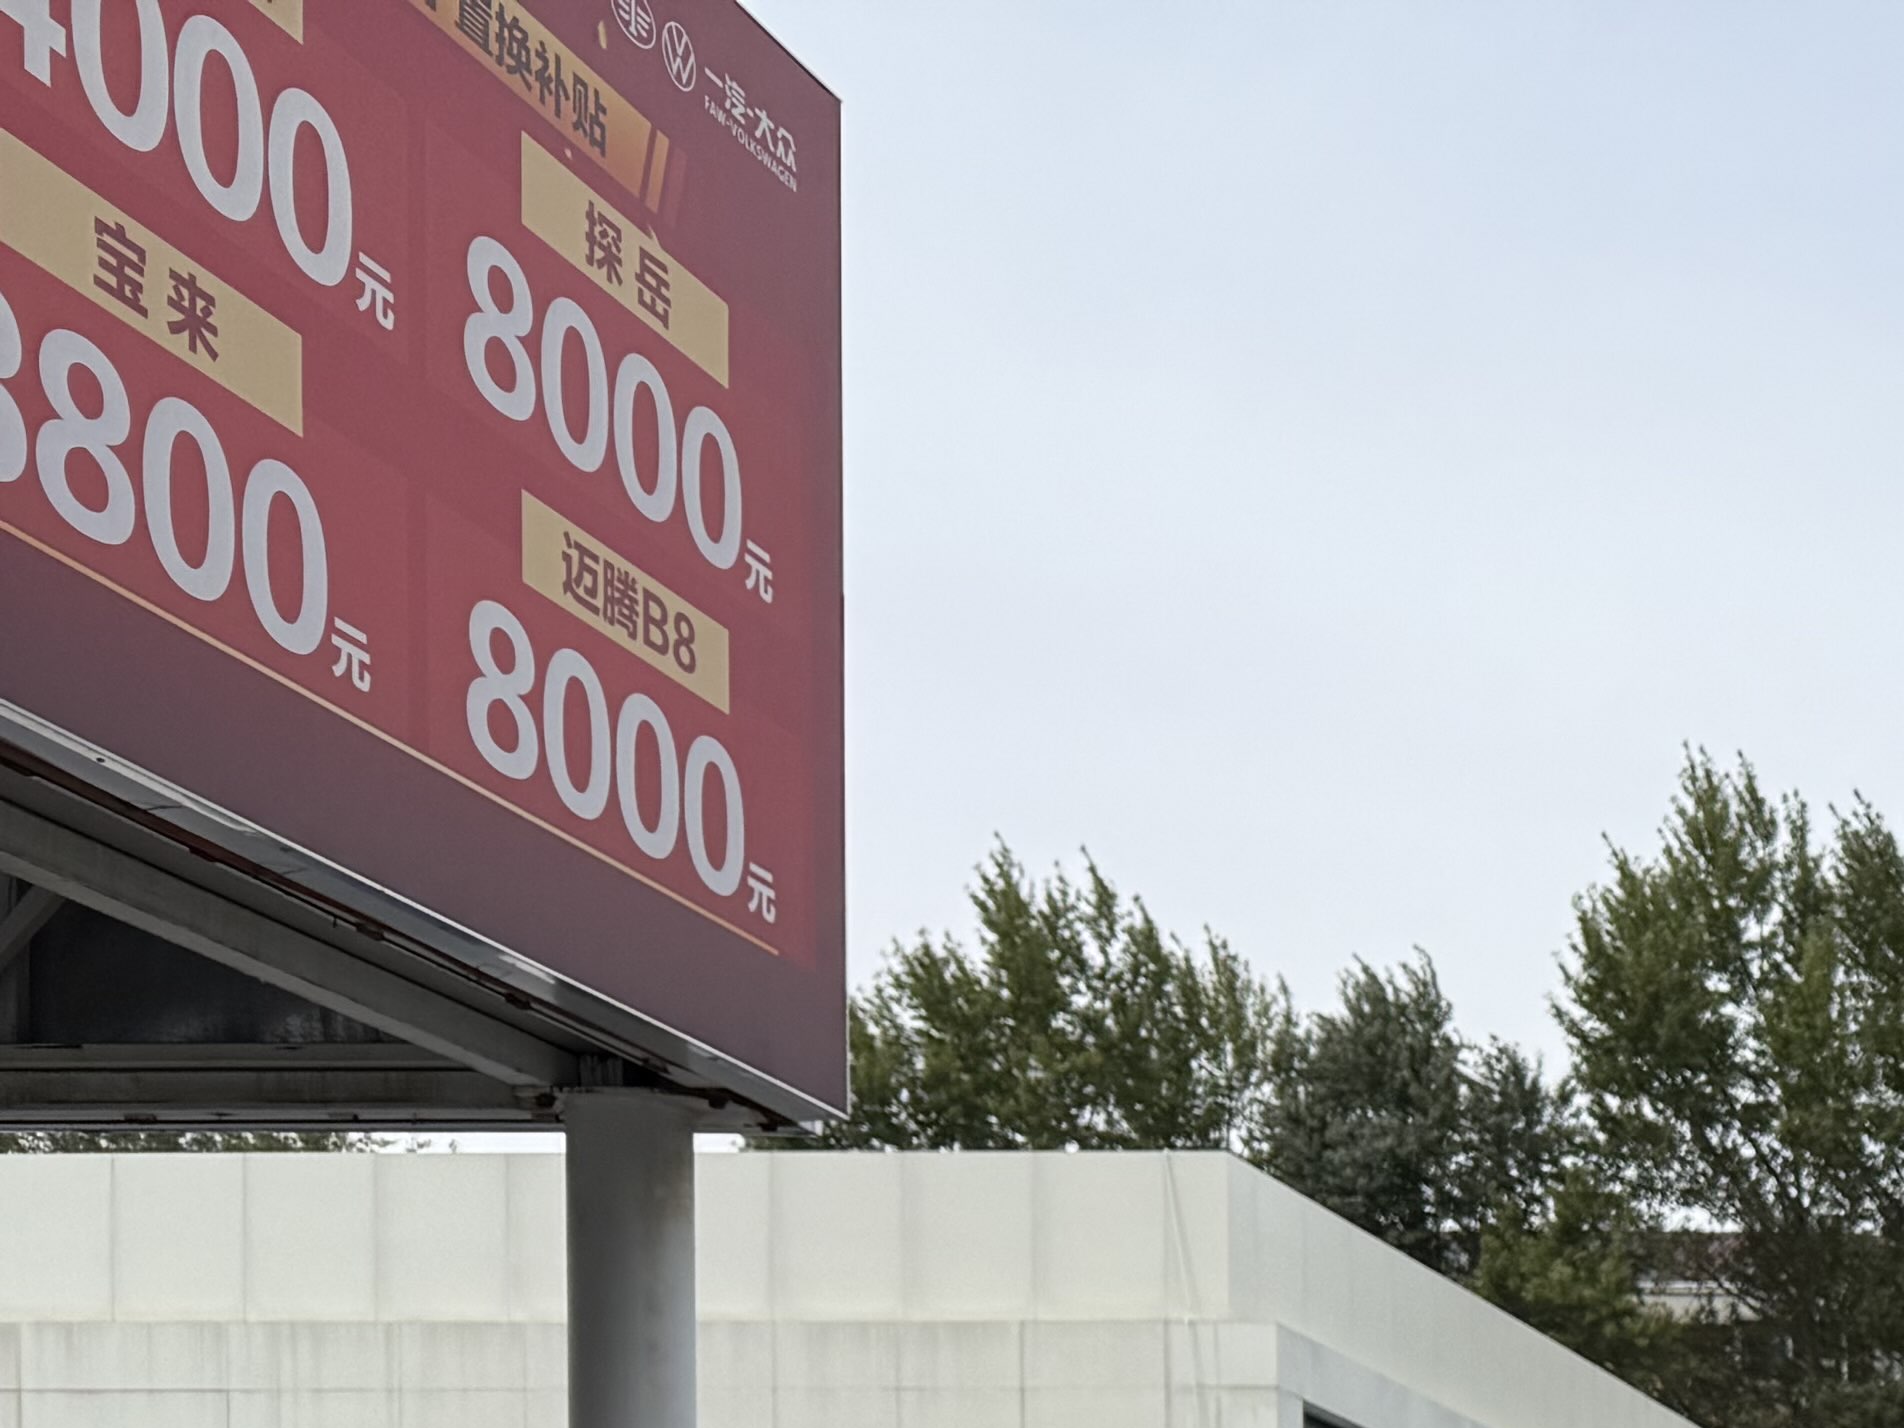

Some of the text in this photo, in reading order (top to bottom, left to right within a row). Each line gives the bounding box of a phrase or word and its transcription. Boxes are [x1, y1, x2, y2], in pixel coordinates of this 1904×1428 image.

[425, 0, 607, 158] 置换补贴
[704, 94, 797, 192] FAW-VOLKSWAGEN
[93, 215, 219, 363] 宝来
[584, 200, 672, 330] 探岳
[561, 529, 698, 676] 迈腾B8
